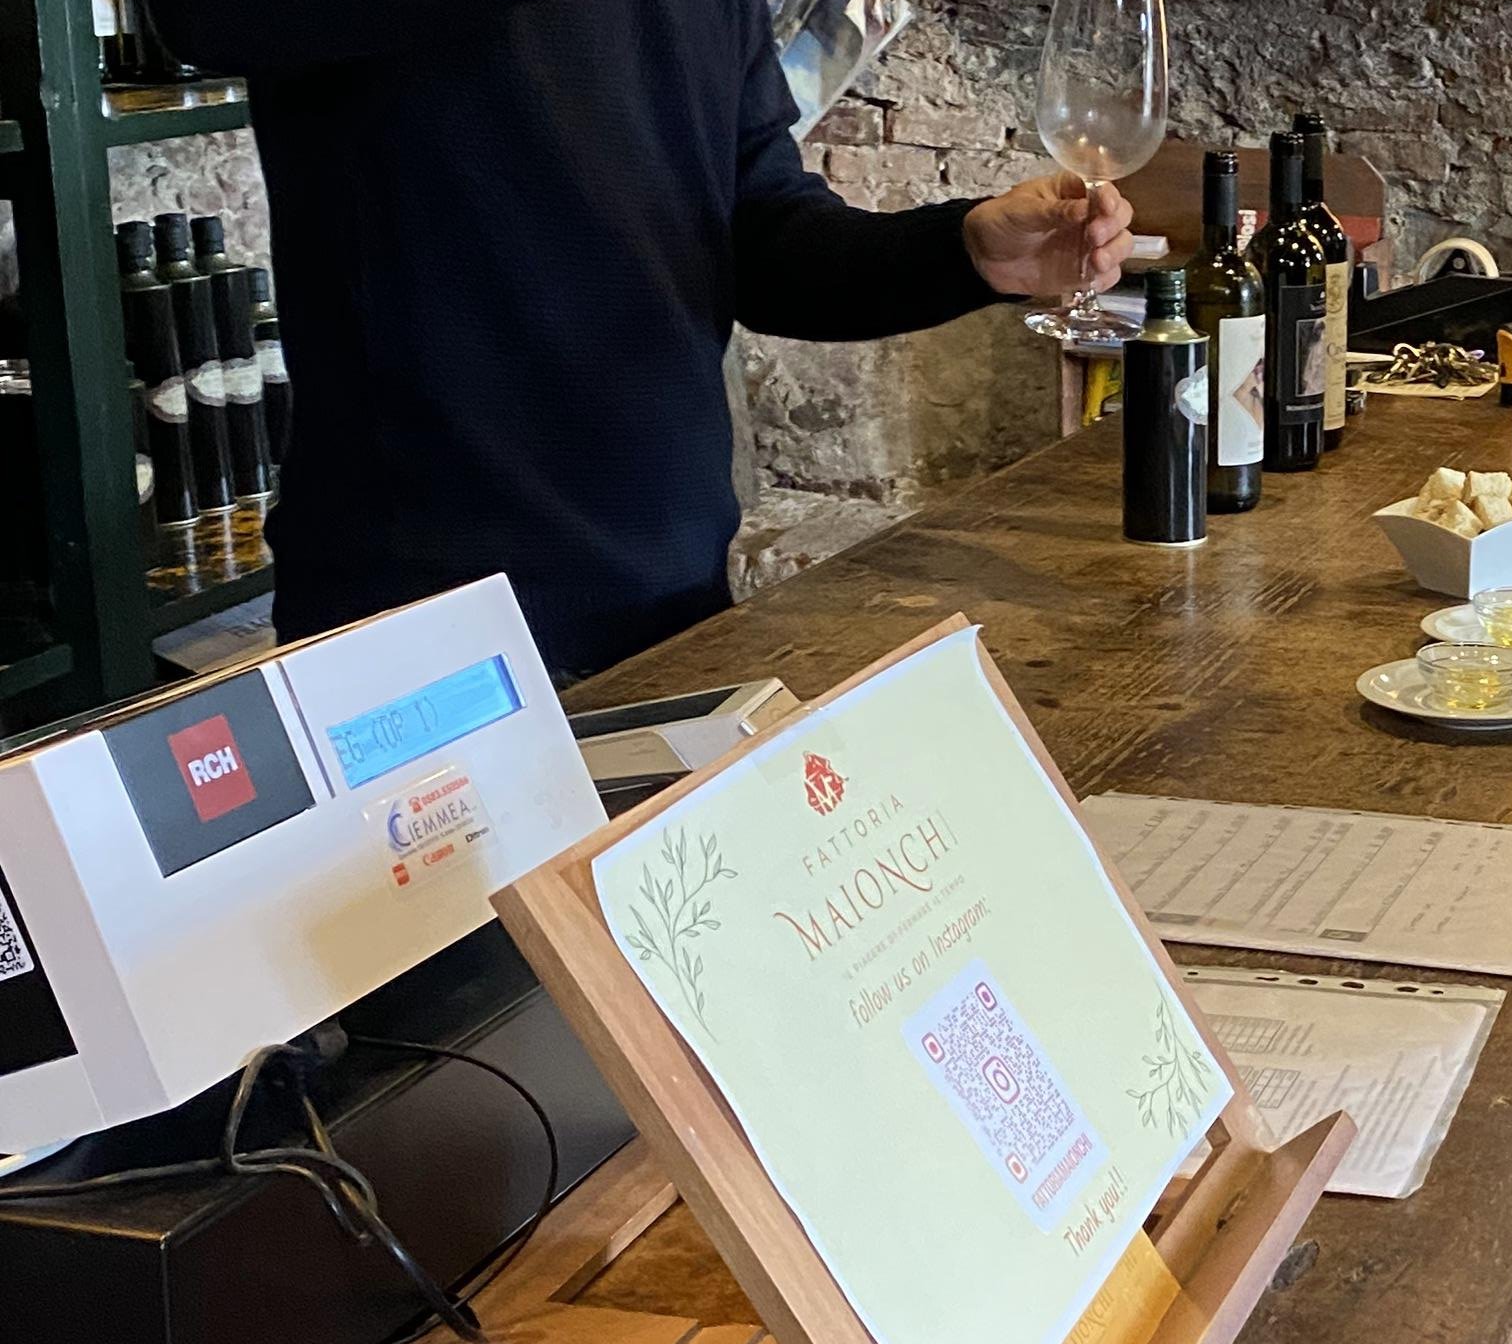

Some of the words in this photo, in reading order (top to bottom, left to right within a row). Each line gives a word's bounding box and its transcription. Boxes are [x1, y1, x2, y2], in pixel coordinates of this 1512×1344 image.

[187, 746, 239, 787] RCH
[389, 799, 471, 848] CIEMMEA
[802, 794, 904, 877] FATTORIA
[773, 809, 959, 962] MAIONCHI
[893, 966, 912, 993] us
[911, 949, 932, 976] on
[928, 896, 993, 959] Instagram:
[1063, 1202, 1104, 1258] Thank
[1098, 1164, 1129, 1224] you!!
